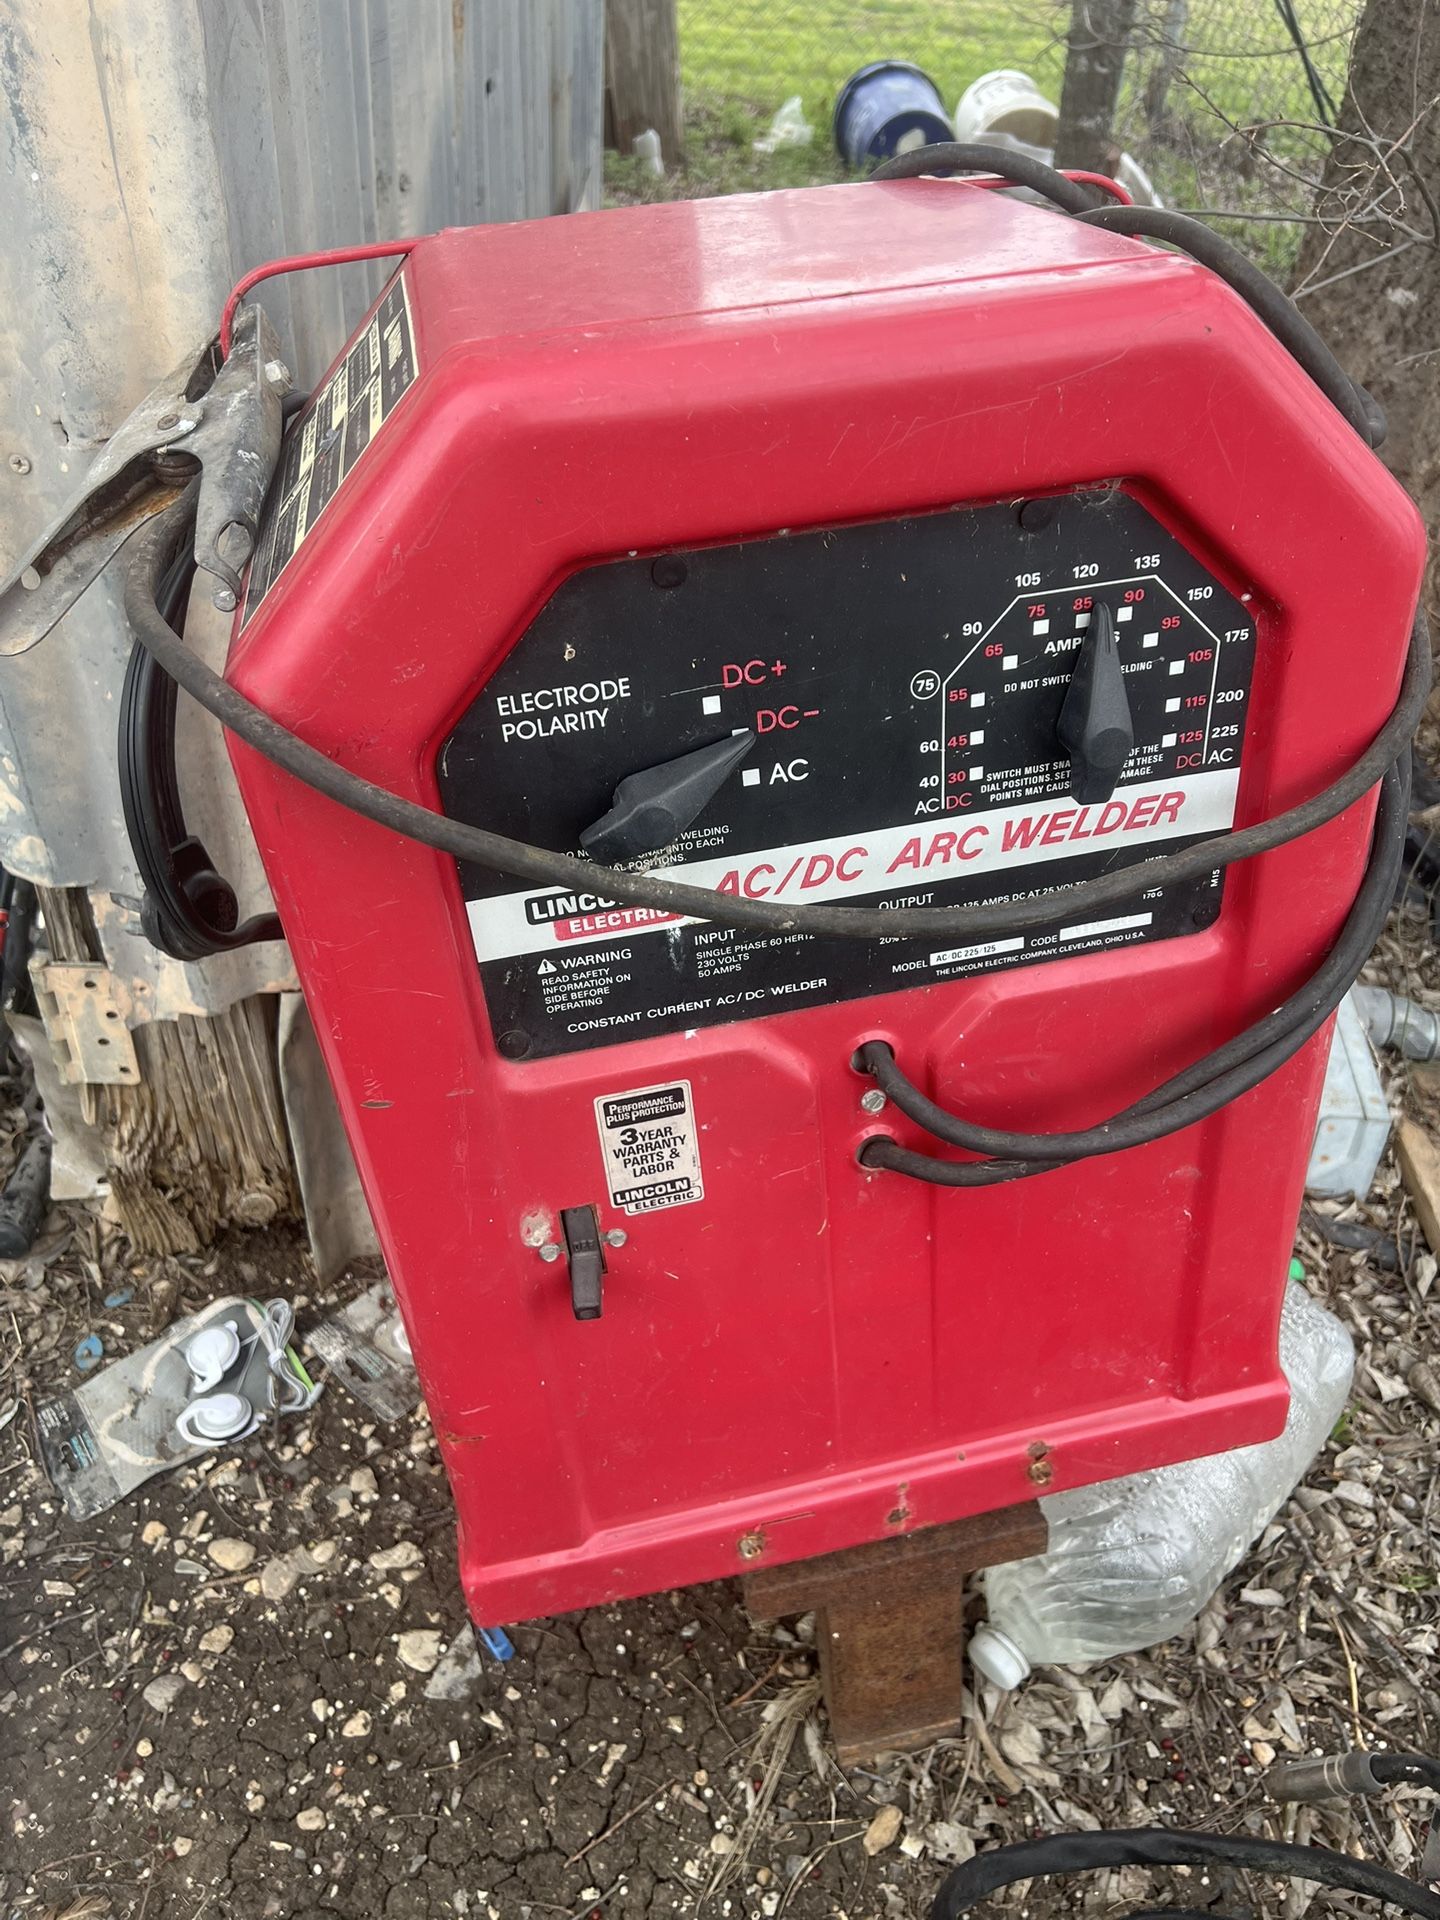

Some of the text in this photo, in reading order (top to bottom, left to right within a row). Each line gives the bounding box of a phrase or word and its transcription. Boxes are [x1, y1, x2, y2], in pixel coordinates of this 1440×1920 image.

[1134, 554, 1161, 570] 135
[1014, 572, 1042, 588] 105
[1072, 563, 1099, 580] 120
[1124, 589, 1145, 603] 90
[1186, 586, 1213, 601] 150
[1027, 604, 1046, 618] 75
[1073, 597, 1093, 611] 85
[962, 621, 983, 637] 90
[1161, 615, 1181, 629] 95
[1224, 629, 1249, 643] 175
[984, 643, 1004, 658] 65
[1187, 649, 1213, 663] 105
[916, 678, 935, 692] 75
[1004, 661, 1153, 693] DO NOT SWITC ELDING
[496, 677, 631, 715] ELECTRODE
[949, 688, 968, 701] 55
[1185, 694, 1207, 708] 115
[1216, 689, 1244, 703] 200
[502, 708, 610, 743] POLARITY
[1211, 725, 1239, 739] 225
[948, 735, 968, 748] 45
[1179, 730, 1204, 743] 125
[919, 740, 940, 754] 60
[986, 768, 1021, 782] SWITCH
[1024, 763, 1050, 775] MUST
[1053, 760, 1071, 770] SNA
[1142, 744, 1159, 754] THE
[1175, 752, 1202, 769] DC
[1207, 748, 1234, 765] AC
[769, 758, 810, 785] AC
[948, 770, 967, 784] 30
[980, 782, 1001, 794] DIAL
[1002, 774, 1053, 790] POSITIONS.
[1136, 753, 1164, 766] THESE
[919, 775, 940, 789] 40
[990, 766, 1154, 802] POINTS MAY CAUS AMAGE.
[914, 797, 941, 816] AC
[946, 791, 972, 810] DC
[681, 824, 732, 841] WELDING.
[696, 836, 724, 849] EACH
[717, 790, 1186, 898] AC/DC ARC WELDER
[879, 893, 934, 910] OUTPUT
[981, 894, 1010, 907] AMPS
[1012, 892, 1026, 900] DC
[1027, 889, 1040, 898] AT
[694, 929, 736, 946] INPUT
[1030, 934, 1058, 947] CODE
[696, 946, 732, 960] SINGLE
[735, 940, 767, 952] PHASE
[770, 937, 783, 947] 60
[936, 969, 950, 977] THE
[951, 961, 983, 974] LINCOLN
[984, 954, 1019, 968] ELECTRIC
[1020, 947, 1058, 961] COMPANY,
[1105, 935, 1124, 945] OHIO
[560, 948, 633, 970] WARNING
[697, 953, 750, 969] 230 VOLTS
[892, 960, 928, 974] MODEL
[541, 967, 610, 987] READ SAFETY
[698, 964, 742, 978] 50 AMPS
[542, 973, 632, 996] INFORMATION ON
[544, 986, 611, 1005] SIDE BEFORE
[546, 997, 603, 1014] OPERATING
[567, 1012, 642, 1034] CONSTANT
[647, 998, 712, 1019] CURRENT
[770, 978, 828, 996] WELDER
[606, 1101, 685, 1127] PLUS PROTECTION
[608, 1095, 674, 1116] PERFORMANCE
[620, 1126, 673, 1146] 3 YEAR
[613, 1134, 687, 1159] WARRANTY
[623, 1148, 681, 1169] PARTS &
[633, 1160, 675, 1178] LABOR
[615, 1179, 689, 1204] LINCOLN
[635, 1191, 695, 1210] ELECTRIC
